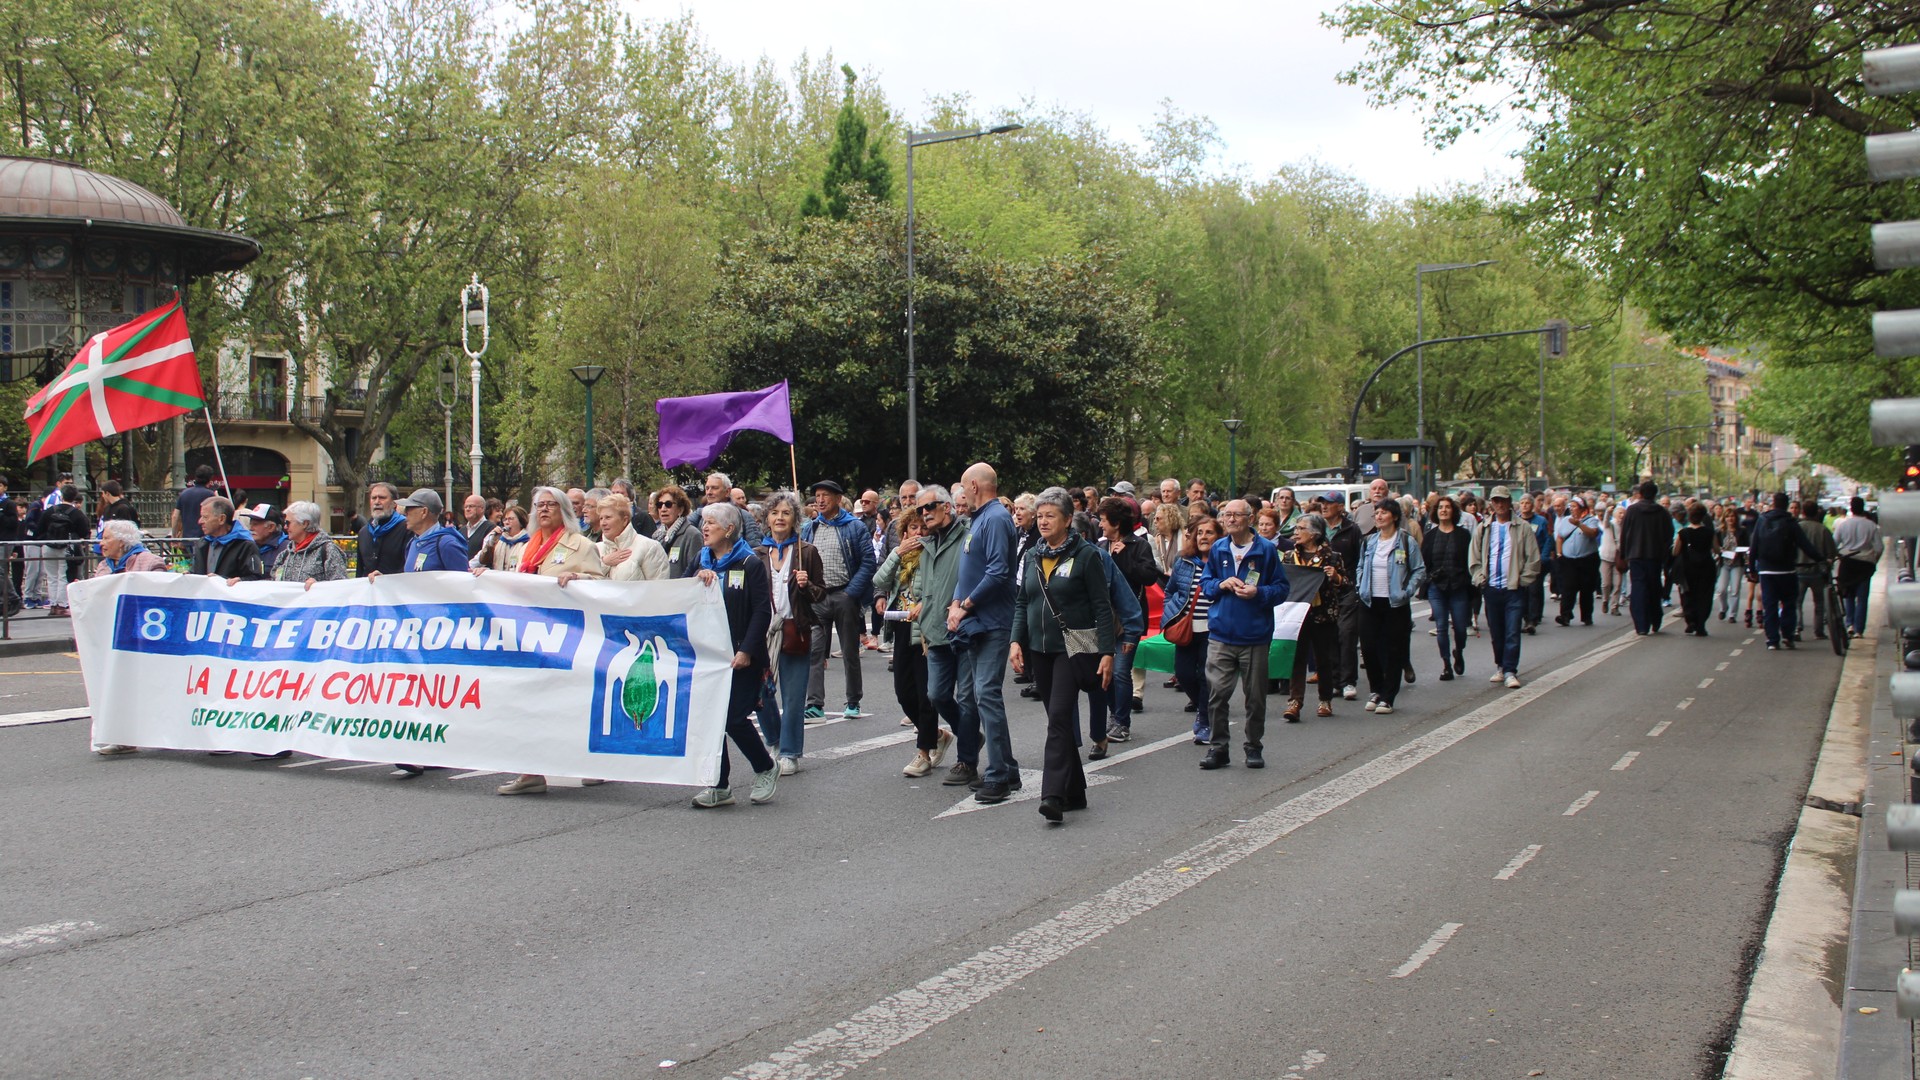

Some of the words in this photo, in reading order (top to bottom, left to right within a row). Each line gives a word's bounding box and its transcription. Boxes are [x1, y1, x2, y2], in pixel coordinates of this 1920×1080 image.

[141, 608, 167, 641] 8
[185, 611, 303, 649] URTE
[307, 617, 569, 653] BORROKAN
[186, 665, 210, 695] LA
[224, 668, 318, 701] LUCHA
[321, 671, 481, 709] CONTINUA
[298, 710, 449, 744] PENTSIODUNAK
